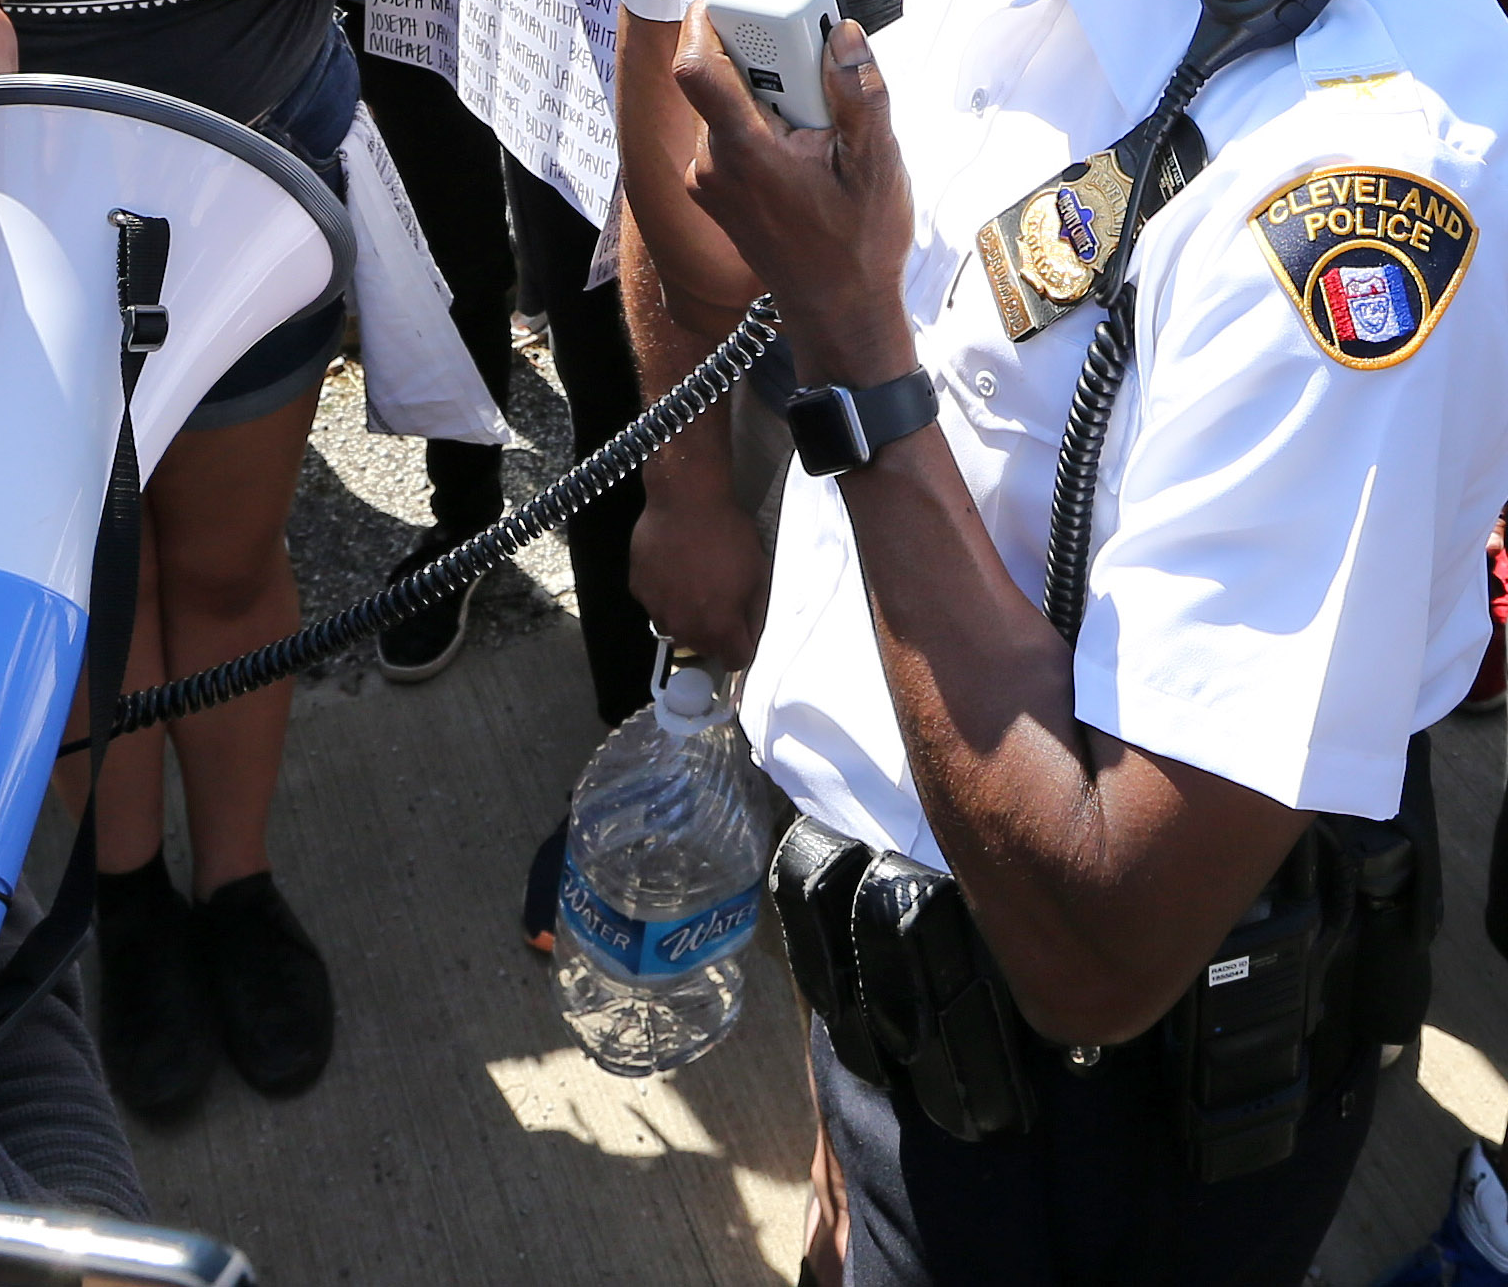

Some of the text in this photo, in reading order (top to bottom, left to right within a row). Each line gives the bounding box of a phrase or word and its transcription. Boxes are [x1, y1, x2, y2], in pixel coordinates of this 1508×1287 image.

[370, 12, 418, 38] JOSEPH
[369, 33, 434, 66] MICHAEL
[1058, 194, 1096, 256] DEPUTY CHIEF
[1267, 175, 1465, 241] CLEVELAND
[1304, 207, 1435, 253] POLICE
[1211, 964, 1237, 974] RADIO
